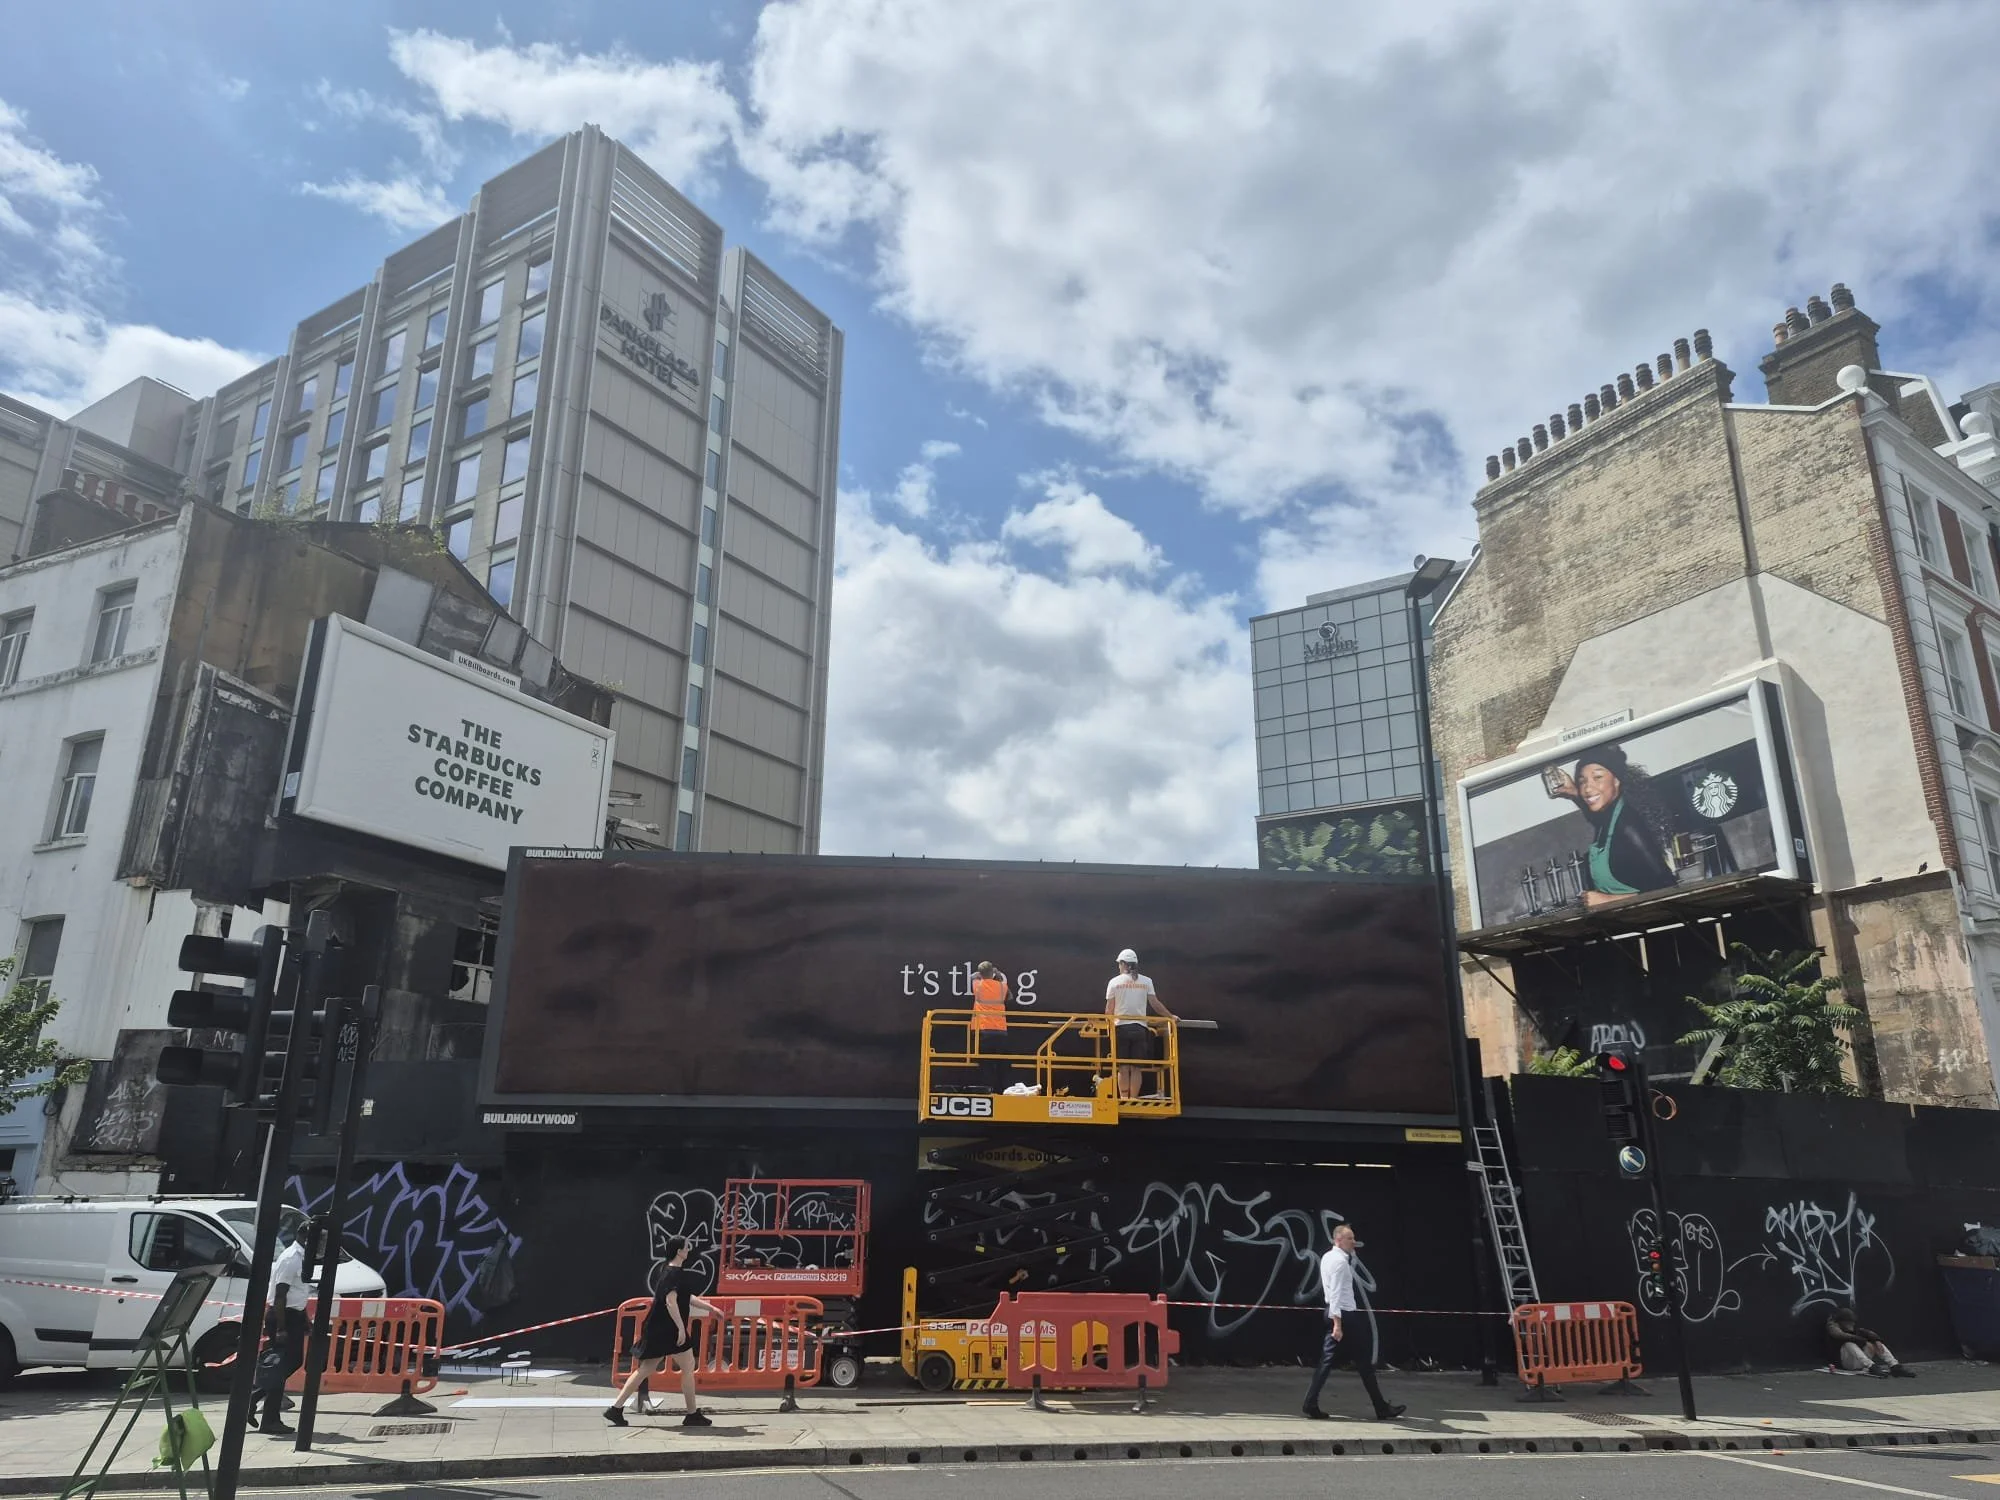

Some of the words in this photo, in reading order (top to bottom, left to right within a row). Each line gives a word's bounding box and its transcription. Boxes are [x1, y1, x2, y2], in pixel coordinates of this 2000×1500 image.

[622, 340, 678, 390] HOTEL
[458, 655, 516, 687] UKBillboards.com
[461, 718, 503, 749] THE
[1562, 716, 1625, 742] UKBillboards.com
[407, 723, 542, 786] STARBUCKS
[434, 757, 514, 799] COFFEE
[415, 776, 524, 825] COMPANY
[525, 848, 603, 860] BUILDHOLLYWOOD
[483, 1112, 577, 1125] BUILDHOLLYWOOD
[930, 1096, 992, 1116] JCB
[726, 1270, 772, 1281] SKYJACK
[819, 1273, 847, 1281] SJ3219
[992, 1324, 1056, 1335] PLFOMS
